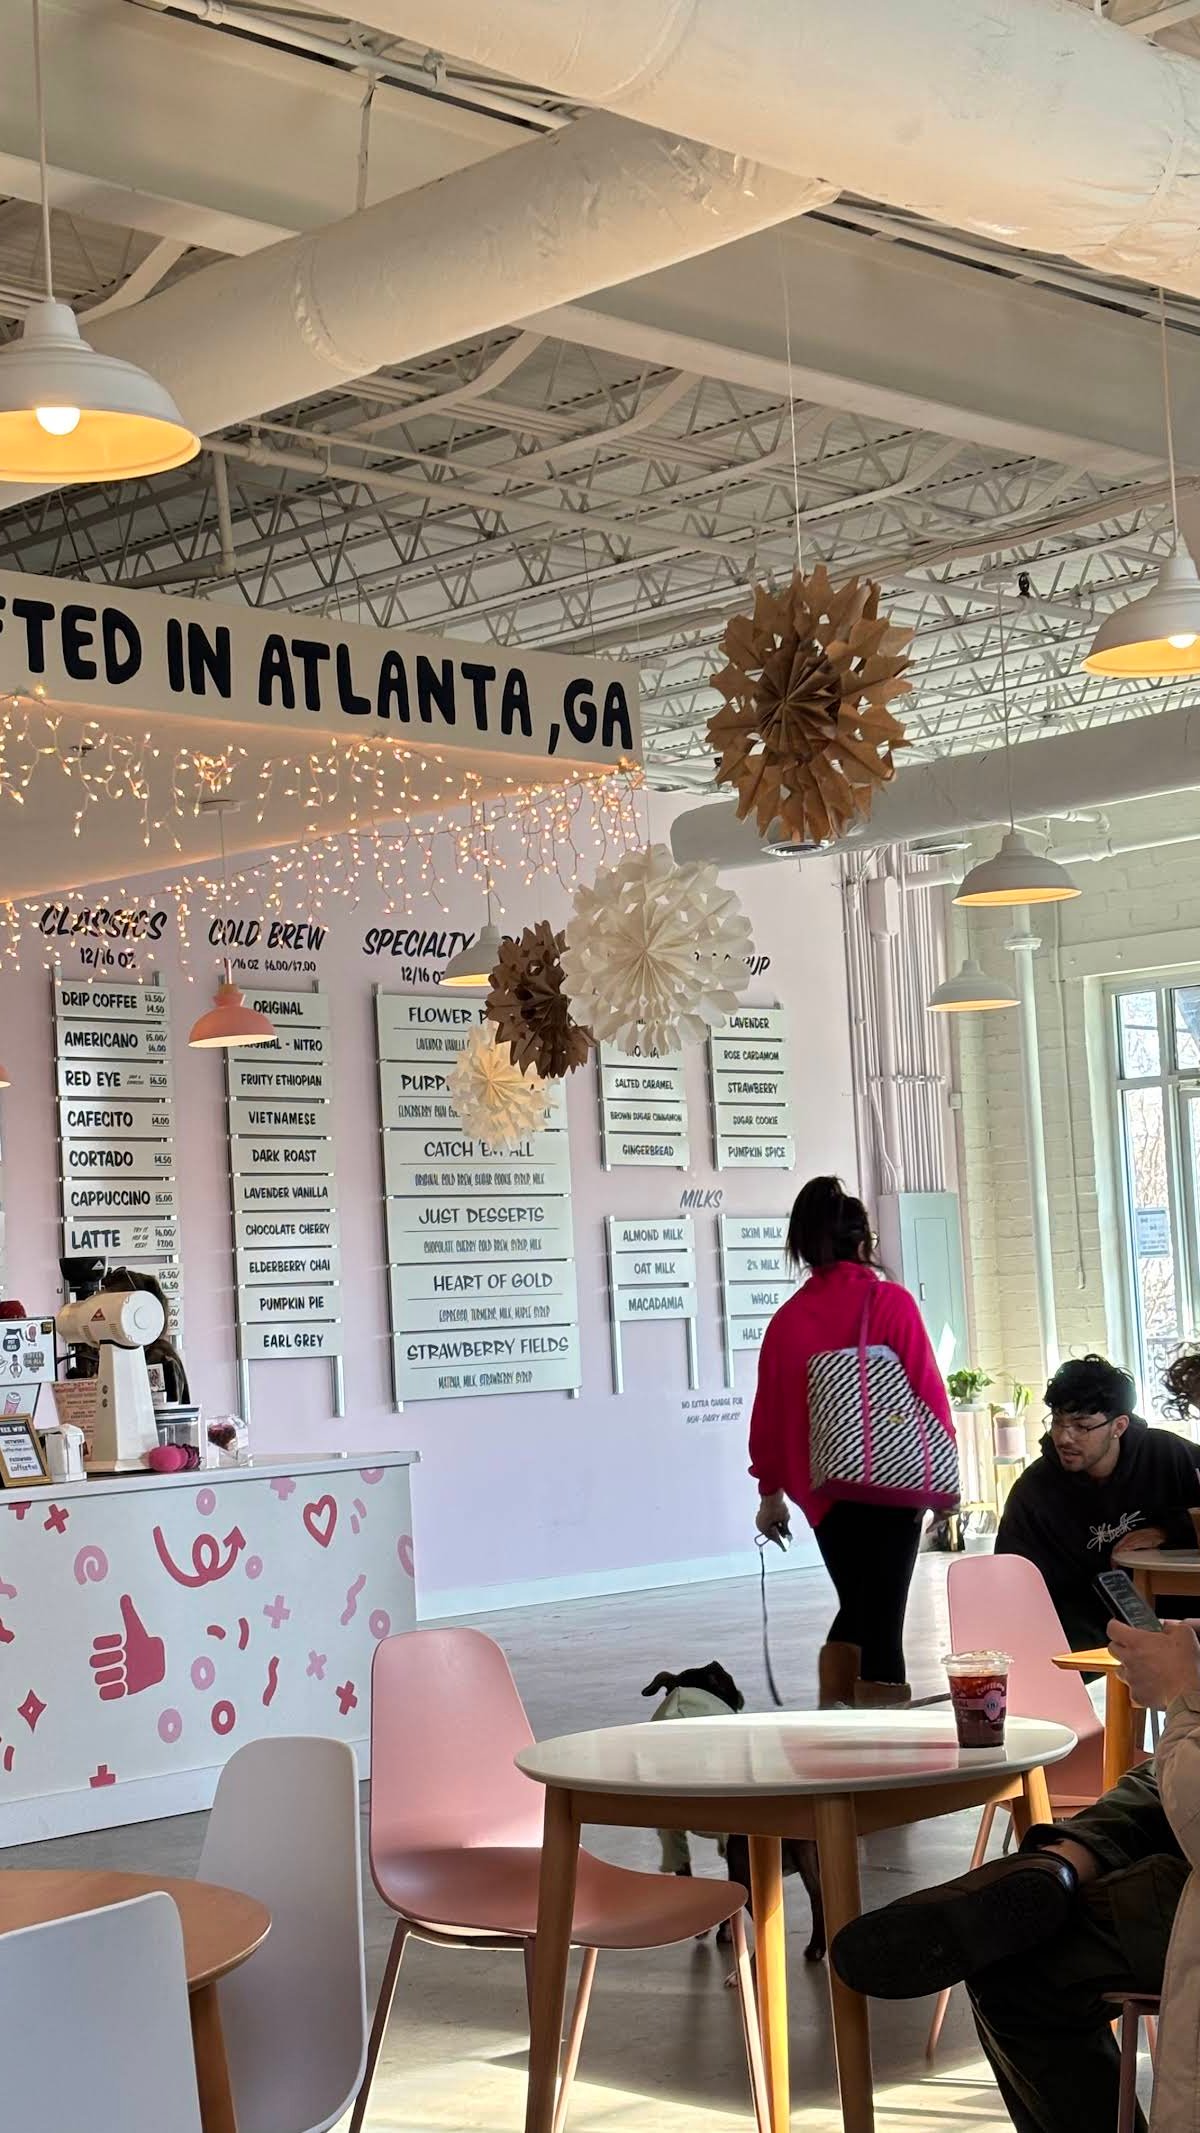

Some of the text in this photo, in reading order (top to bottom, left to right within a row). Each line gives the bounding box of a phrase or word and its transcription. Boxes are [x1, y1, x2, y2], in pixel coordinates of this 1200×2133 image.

[0, 594, 141, 685] TED
[168, 618, 231, 698] IN
[39, 904, 168, 941] CLASSICS
[208, 918, 327, 951] COLD BREW
[362, 927, 476, 960] SPECIALTY
[80, 947, 137, 969] 12/16 OZ
[247, 959, 259, 970] OZ
[401, 966, 430, 986] 12/16
[61, 991, 138, 1009] DRIP COFFEE
[253, 1000, 304, 1016] ORIGINAL
[408, 1006, 473, 1025] FLOWER
[729, 1017, 770, 1030] LAVENDER
[64, 1031, 139, 1048] AMERICANO
[240, 1037, 282, 1050] IGINAL
[293, 1038, 323, 1052] NITRO
[416, 1037, 443, 1051] LAVENDER
[723, 1050, 779, 1061] ROSE CARDAMOM
[65, 1070, 91, 1087] RED
[96, 1071, 122, 1087] EYE
[241, 1073, 322, 1087] FRUITY ETHIOPIAN
[401, 1074, 450, 1092] PURP
[615, 1078, 674, 1091] SALTED CARAMEL
[727, 1082, 778, 1094] STRAWBERRY
[67, 1110, 134, 1128] CAFECITO
[248, 1110, 317, 1126] VIETNAMESE
[398, 1104, 433, 1118] ELDERBERRY
[610, 1111, 682, 1122] BROWN SUGAR CINNAMON
[732, 1115, 779, 1126] SUGAR COOKIE
[252, 1149, 317, 1163] DARK ROAST
[424, 1141, 474, 1157] CATCH
[622, 1144, 674, 1156] GINGERBREAD
[728, 1146, 786, 1158] PUMPKIN SPICE
[69, 1150, 134, 1168] CORTADO
[415, 1173, 440, 1187] ORIGINAL
[441, 1173, 456, 1186] COLD
[474, 1173, 493, 1186] SUGAR
[494, 1173, 512, 1186] COOKIE
[532, 1172, 545, 1185] MILK
[71, 1190, 151, 1207] CAPPUCCINO
[244, 1186, 329, 1199] LAVENDER VANILLA
[679, 1189, 723, 1209] MILKS
[418, 1206, 545, 1225] JUST DESSERTS
[245, 1223, 330, 1236] CHOCOLATE CHERRY
[622, 1228, 684, 1242] ALMOND MILK
[741, 1226, 782, 1239] SKIM MILK
[71, 1229, 121, 1250] LATTE
[423, 1241, 455, 1254] CHOCOLATE
[456, 1240, 477, 1254] CHERRY
[478, 1239, 493, 1252] COLD
[529, 1238, 543, 1251] MILK
[249, 1258, 331, 1274] ELDERBERRY CHAI
[634, 1262, 676, 1275] OAT MILK
[747, 1259, 780, 1272] 2% MILK
[433, 1272, 554, 1292] HEART OF GOLD
[259, 1295, 325, 1311] PUMPKIN PIE
[628, 1296, 684, 1312] MACADAMIA
[751, 1293, 780, 1305] WHOLE
[514, 1305, 533, 1319] MAPLE
[533, 1304, 551, 1318] SYRUP
[263, 1333, 324, 1349] EARL GREY
[742, 1328, 763, 1341] HALF
[407, 1336, 570, 1361] STRAWBERRY FIELDS
[479, 1371, 514, 1387] STRAWBERRY
[515, 1370, 533, 1384] SYRUP
